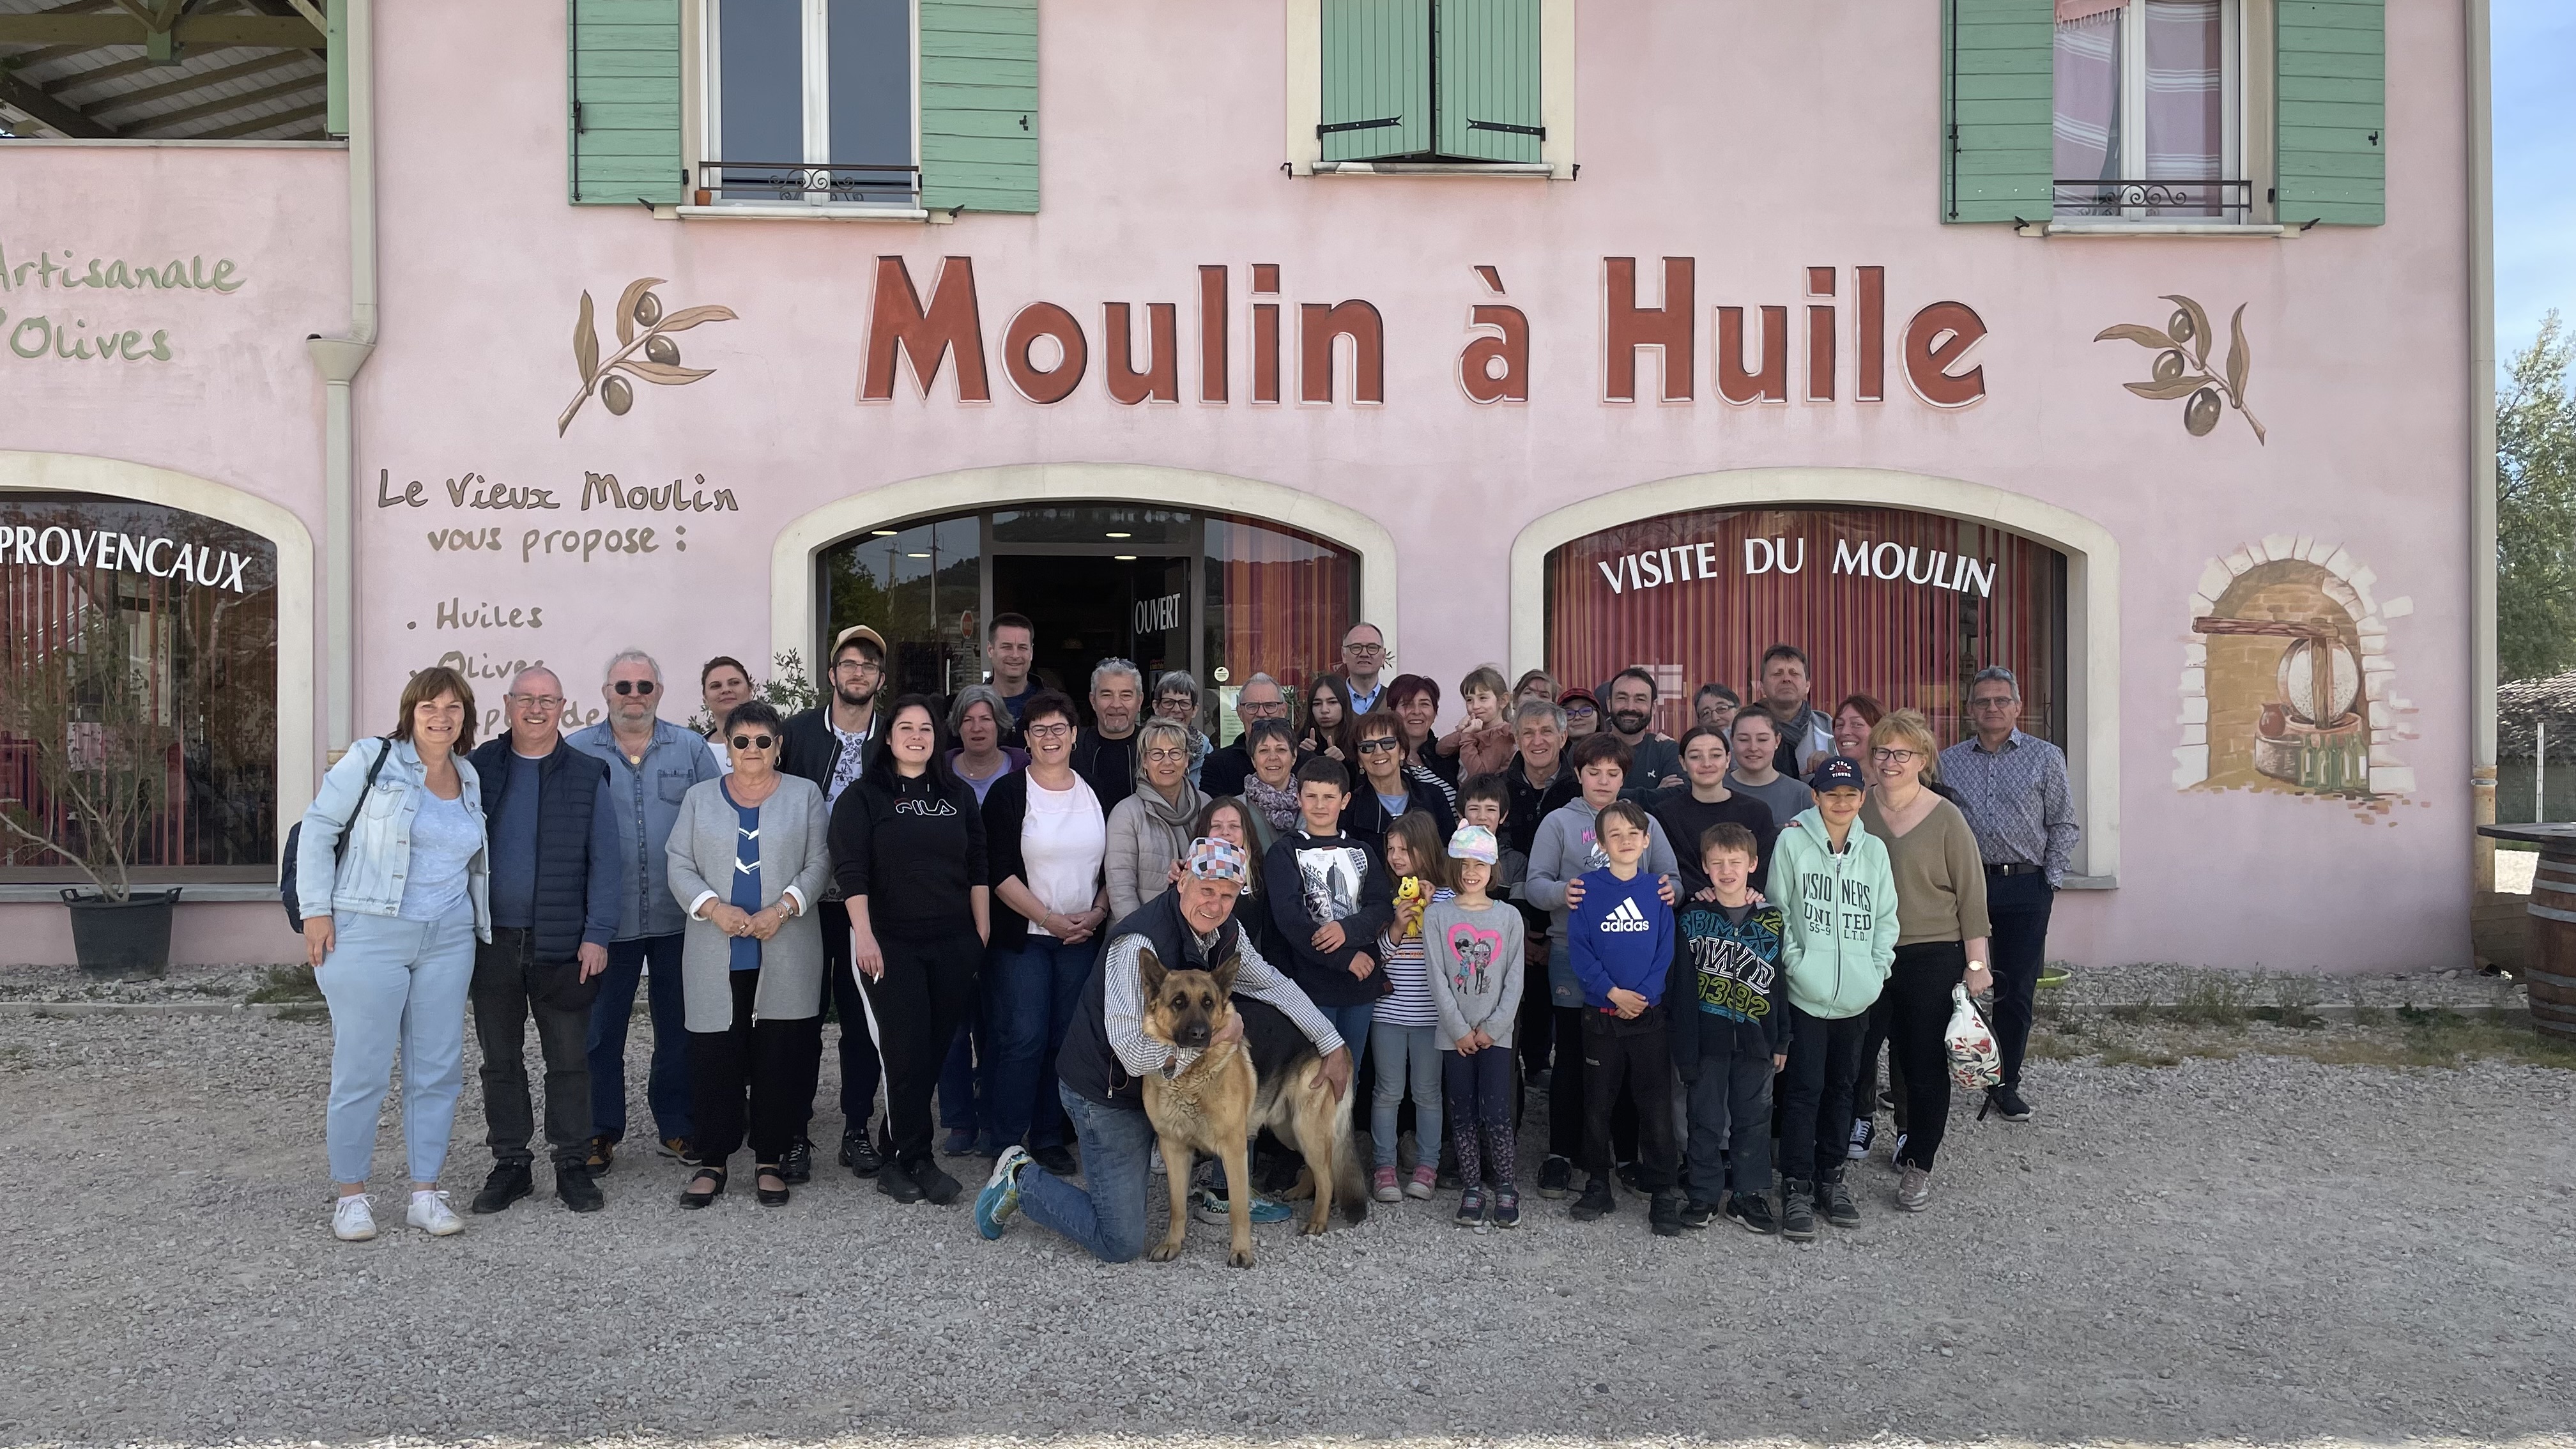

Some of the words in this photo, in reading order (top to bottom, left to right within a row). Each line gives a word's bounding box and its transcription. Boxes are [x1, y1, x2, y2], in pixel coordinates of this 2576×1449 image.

[859, 256, 1384, 404] Moulin
[1458, 265, 1529, 404] à
[1602, 256, 1988, 409] Huile
[378, 468, 429, 509] Le
[447, 472, 561, 510] Vieux
[580, 470, 739, 512] Moulin
[0, 526, 252, 594] PROVENCAUX
[427, 527, 502, 551] vous
[522, 526, 660, 563] propose
[1597, 541, 1717, 595] VISITE
[1745, 537, 1804, 575] DU
[1832, 539, 1997, 599] MOULIN
[436, 597, 544, 630] Huiles
[1135, 592, 1181, 634] OUVERT
[894, 797, 957, 816] FILA
[1600, 919, 1650, 932] adidas
